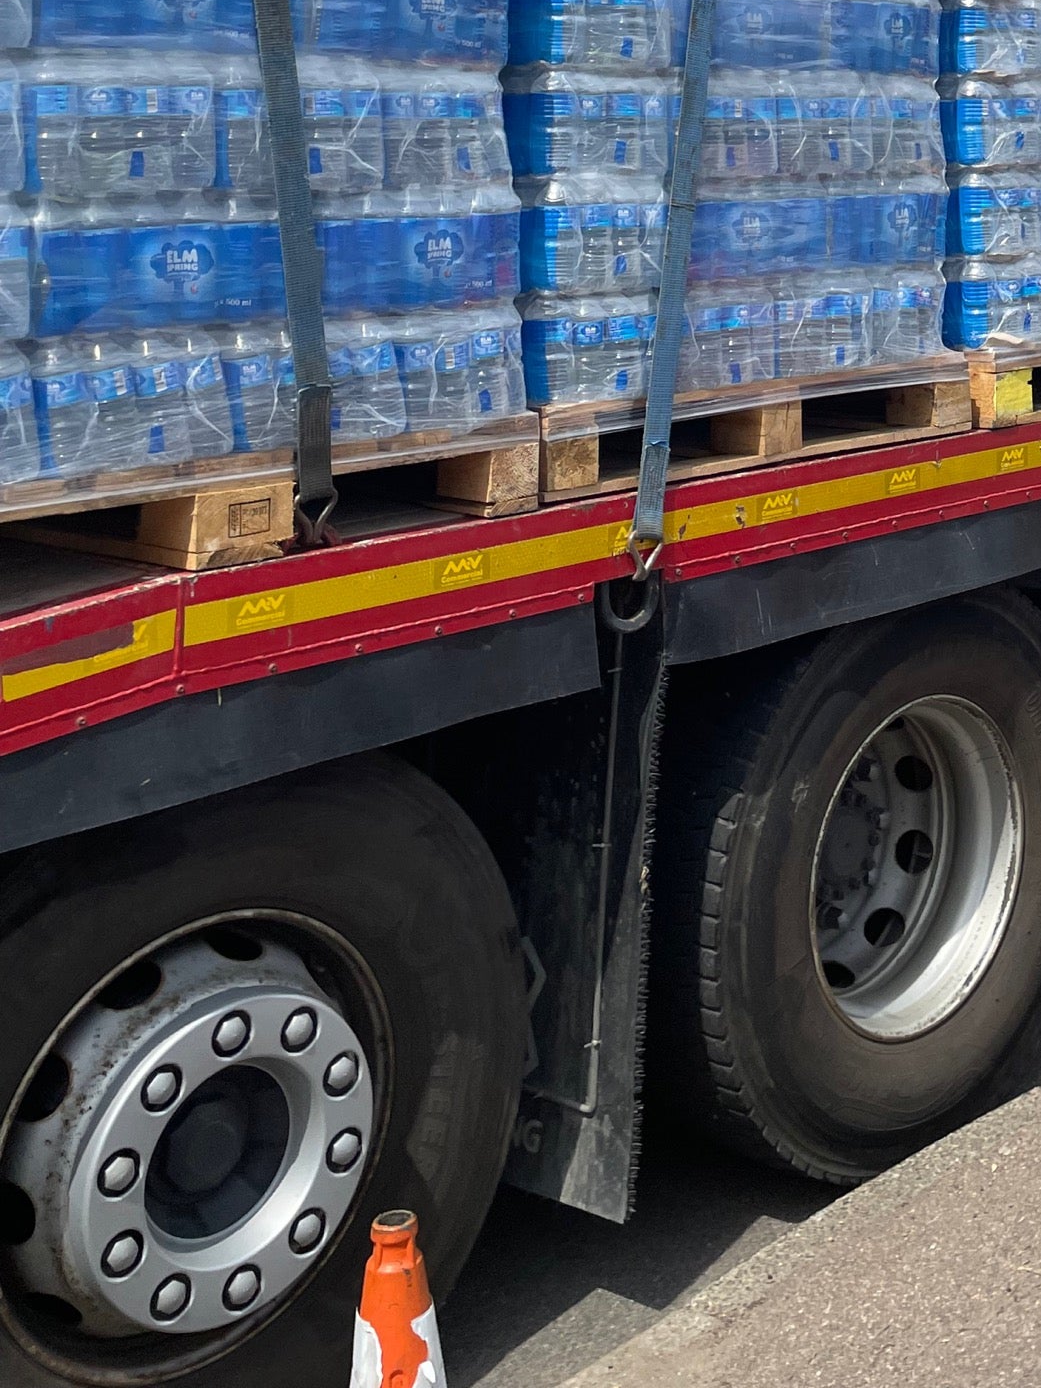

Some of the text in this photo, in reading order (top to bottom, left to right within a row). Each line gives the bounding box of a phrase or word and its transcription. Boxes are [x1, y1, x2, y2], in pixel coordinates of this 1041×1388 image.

[427, 236, 453, 252] ELM
[166, 248, 198, 264] ELM
[166, 263, 199, 273] SPRING
